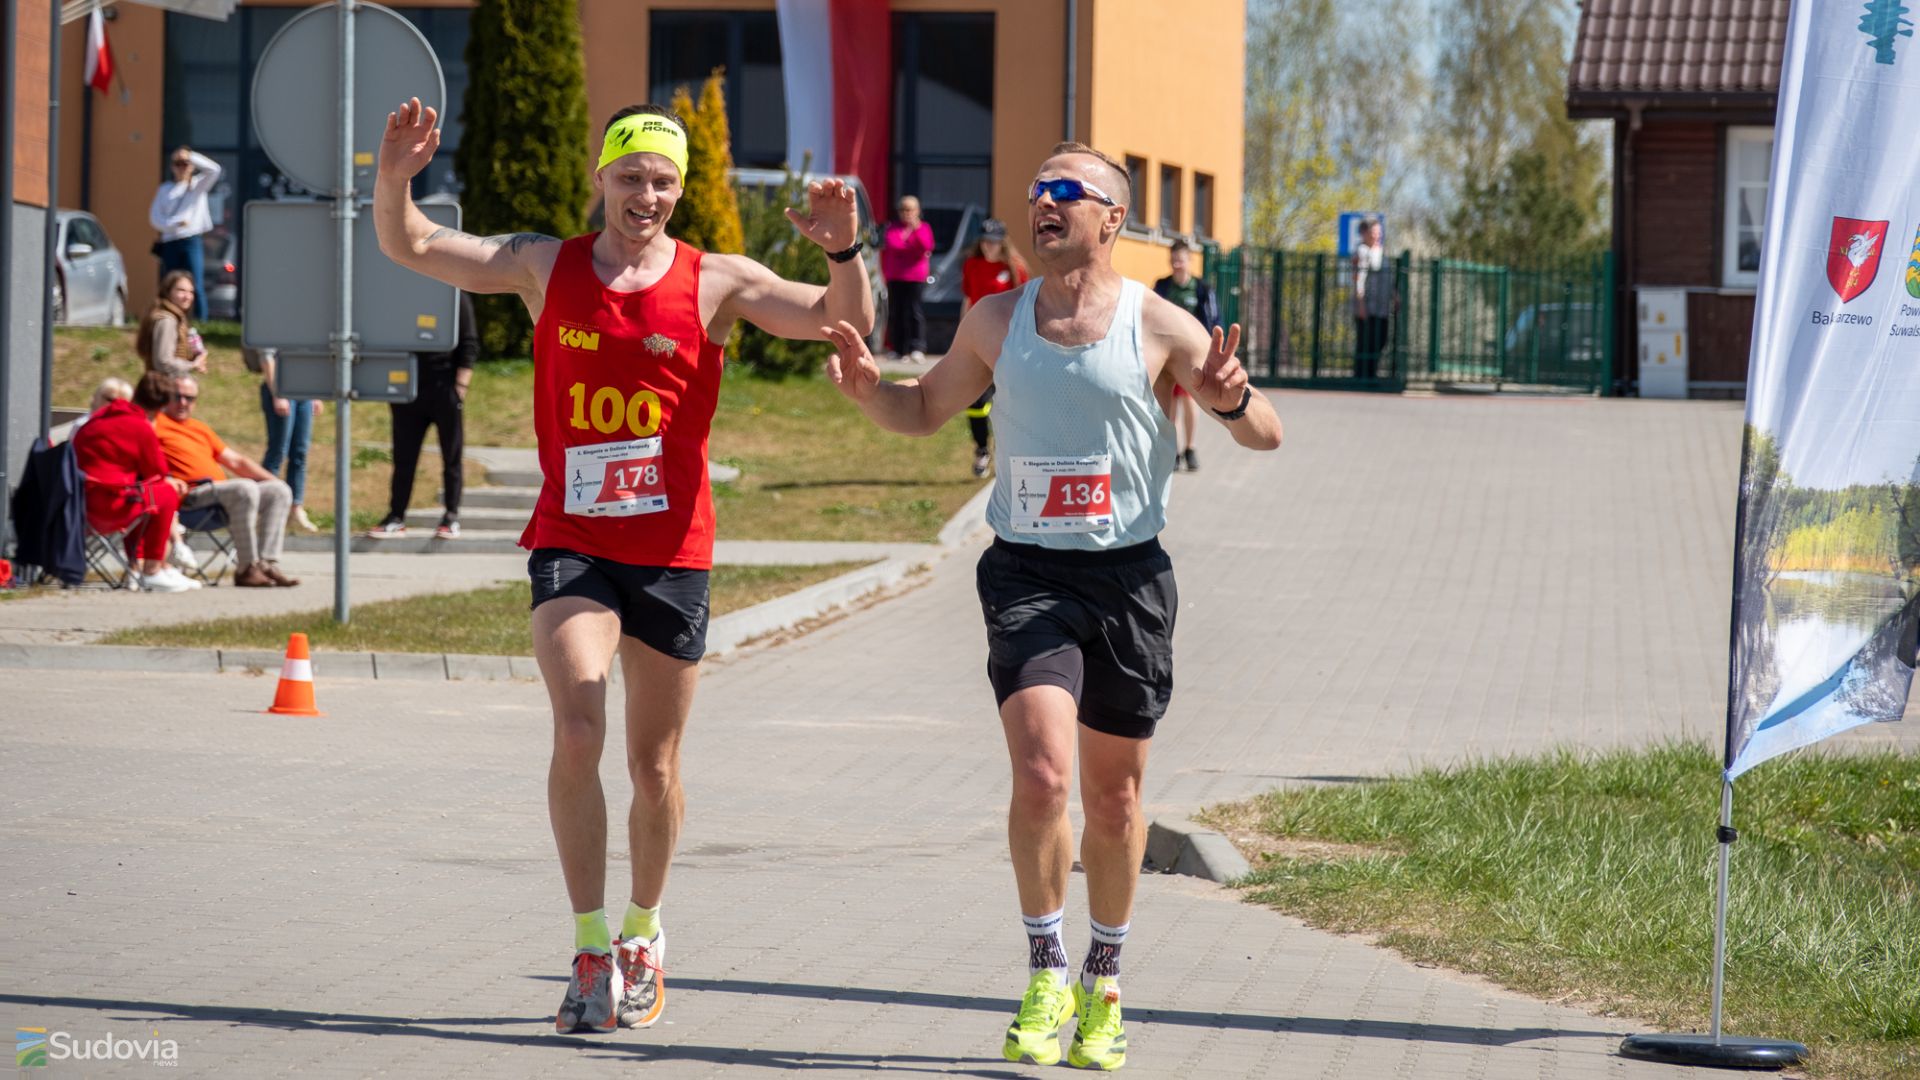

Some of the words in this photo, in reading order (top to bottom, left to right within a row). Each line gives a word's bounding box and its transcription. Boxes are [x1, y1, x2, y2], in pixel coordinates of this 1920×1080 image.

[641, 126, 678, 136] MORE
[568, 382, 662, 437] 100
[614, 465, 659, 490] 178
[1061, 482, 1105, 506] 136
